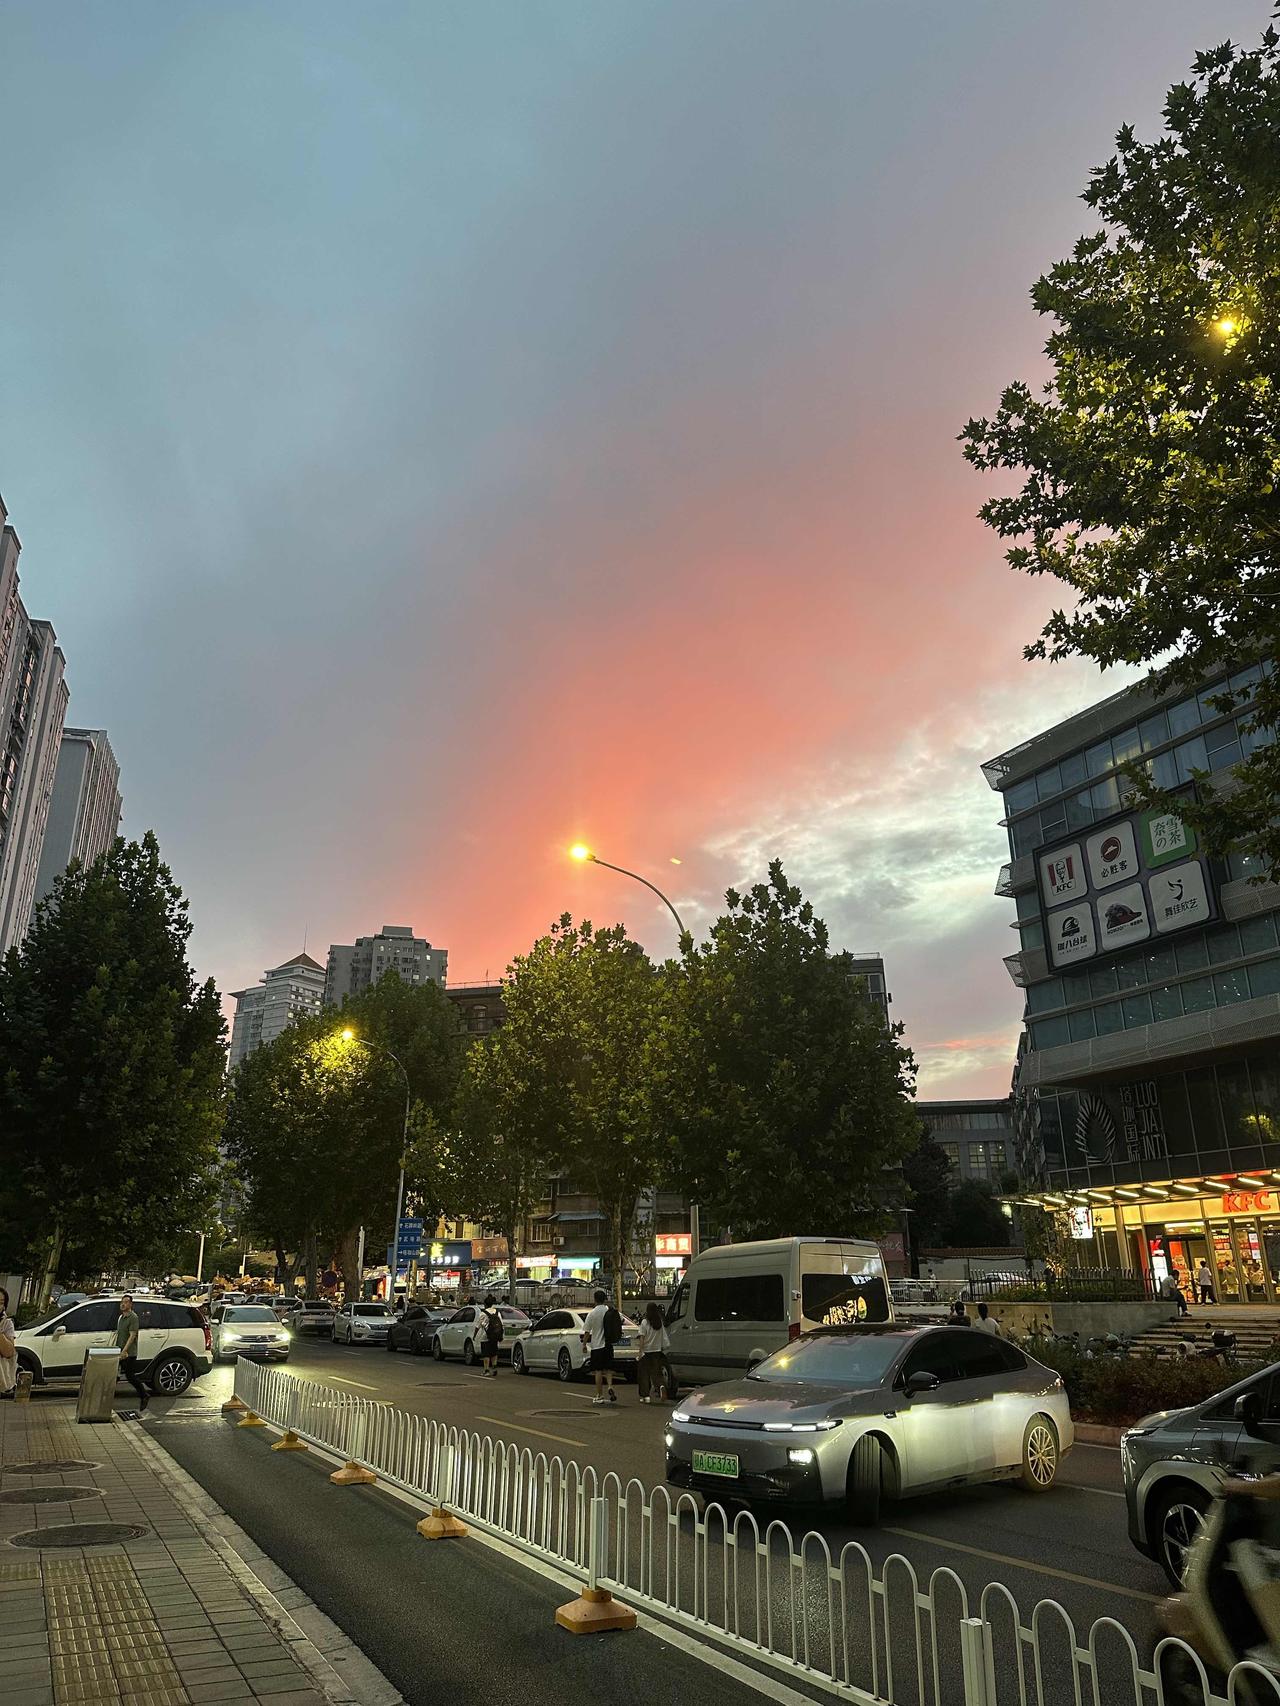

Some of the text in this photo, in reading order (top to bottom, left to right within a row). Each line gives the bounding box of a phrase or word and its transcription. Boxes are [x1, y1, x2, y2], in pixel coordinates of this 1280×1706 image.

[1101, 860, 1128, 878] 必胜客
[1056, 881, 1073, 893] KFC
[1222, 1191, 1271, 1213] KFC
